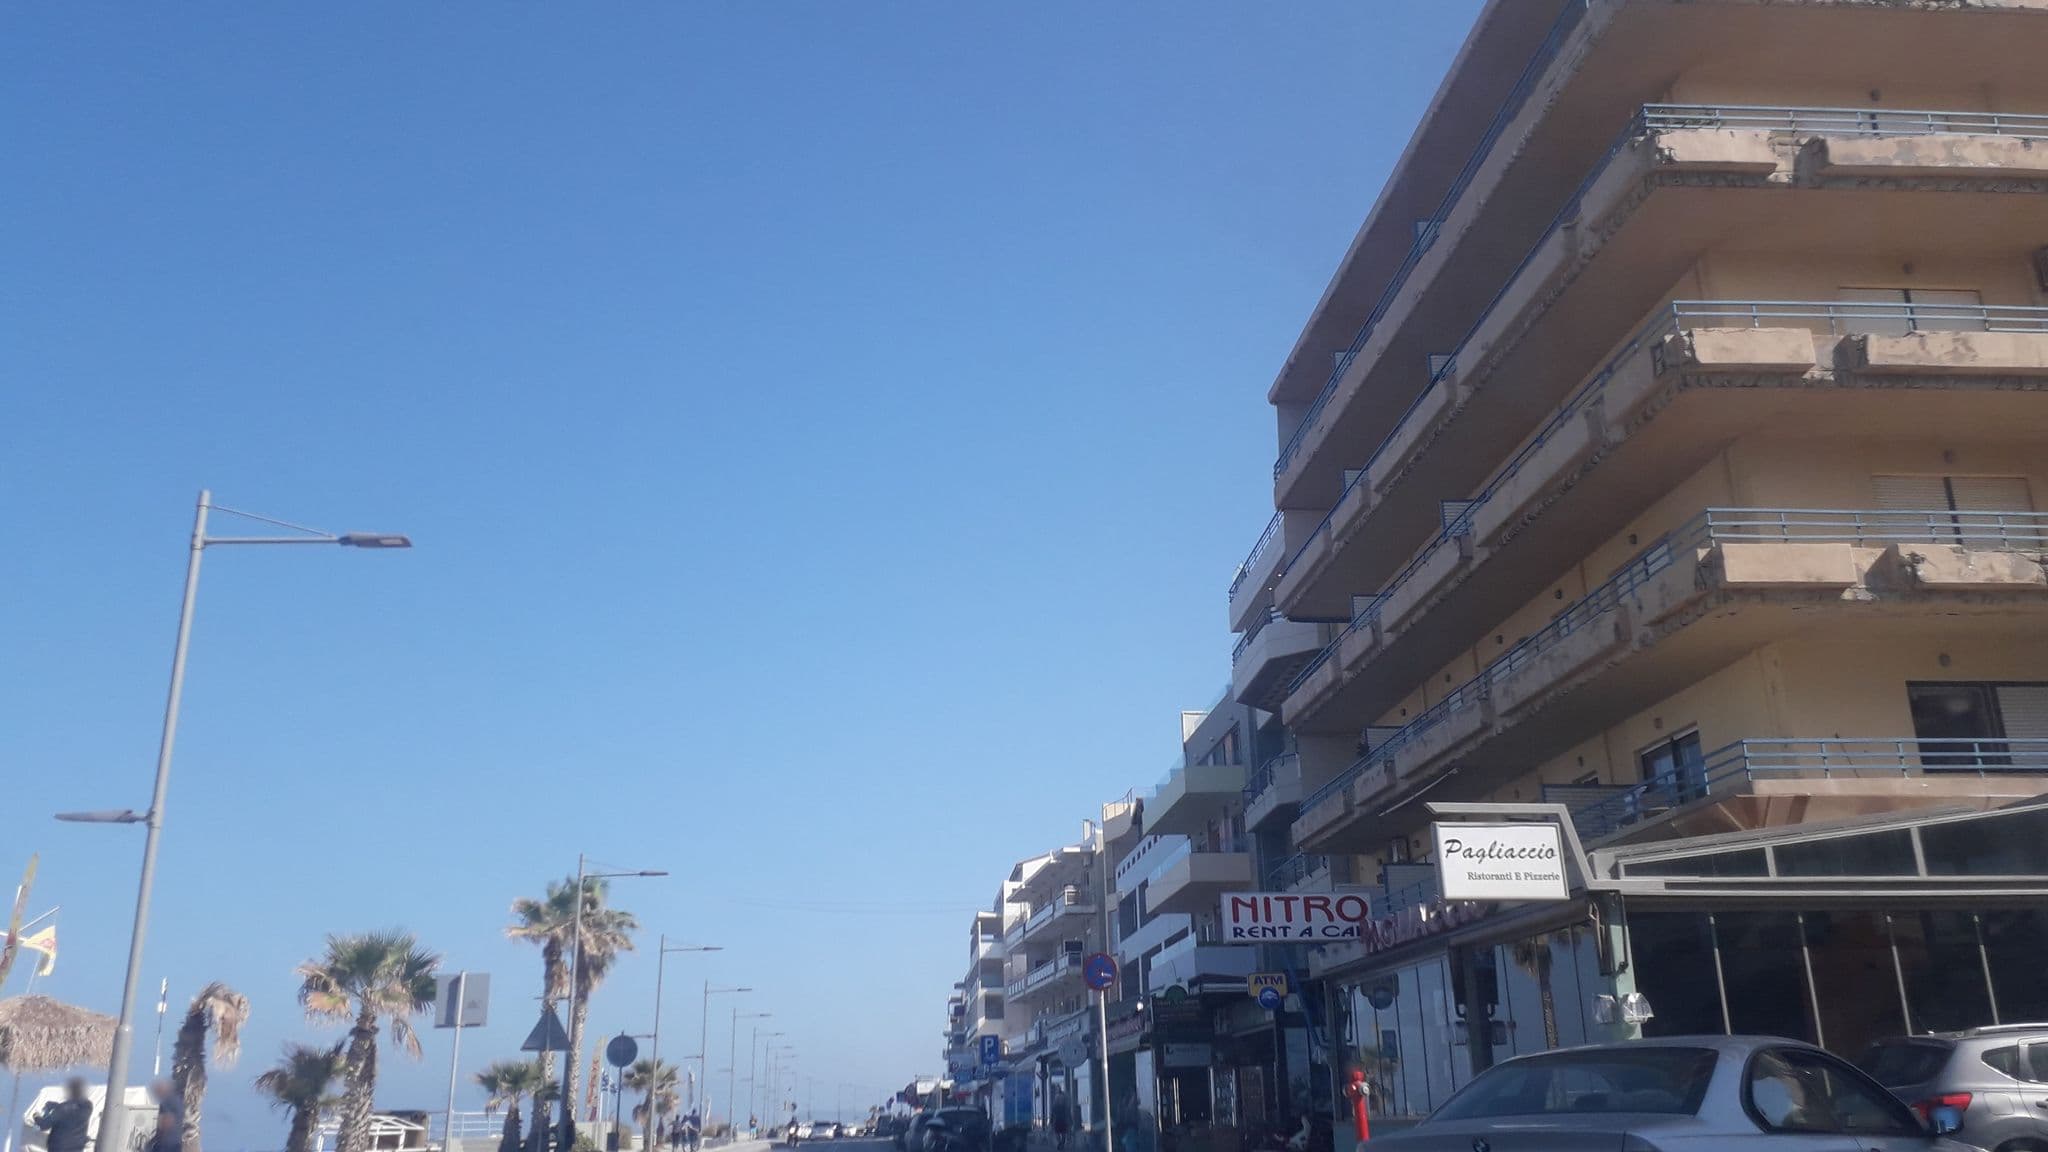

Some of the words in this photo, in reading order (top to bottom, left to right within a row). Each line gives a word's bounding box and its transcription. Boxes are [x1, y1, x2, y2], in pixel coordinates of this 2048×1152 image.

[1444, 839, 1557, 864] Pagliaccio
[1467, 871, 1513, 881] Ristoranti
[1515, 872, 1522, 881] E
[1231, 895, 1369, 923] NITRO
[1233, 926, 1292, 938] RENT
[1299, 926, 1313, 938] A
[1254, 975, 1284, 985] ATM
[984, 1037, 995, 1053] P
